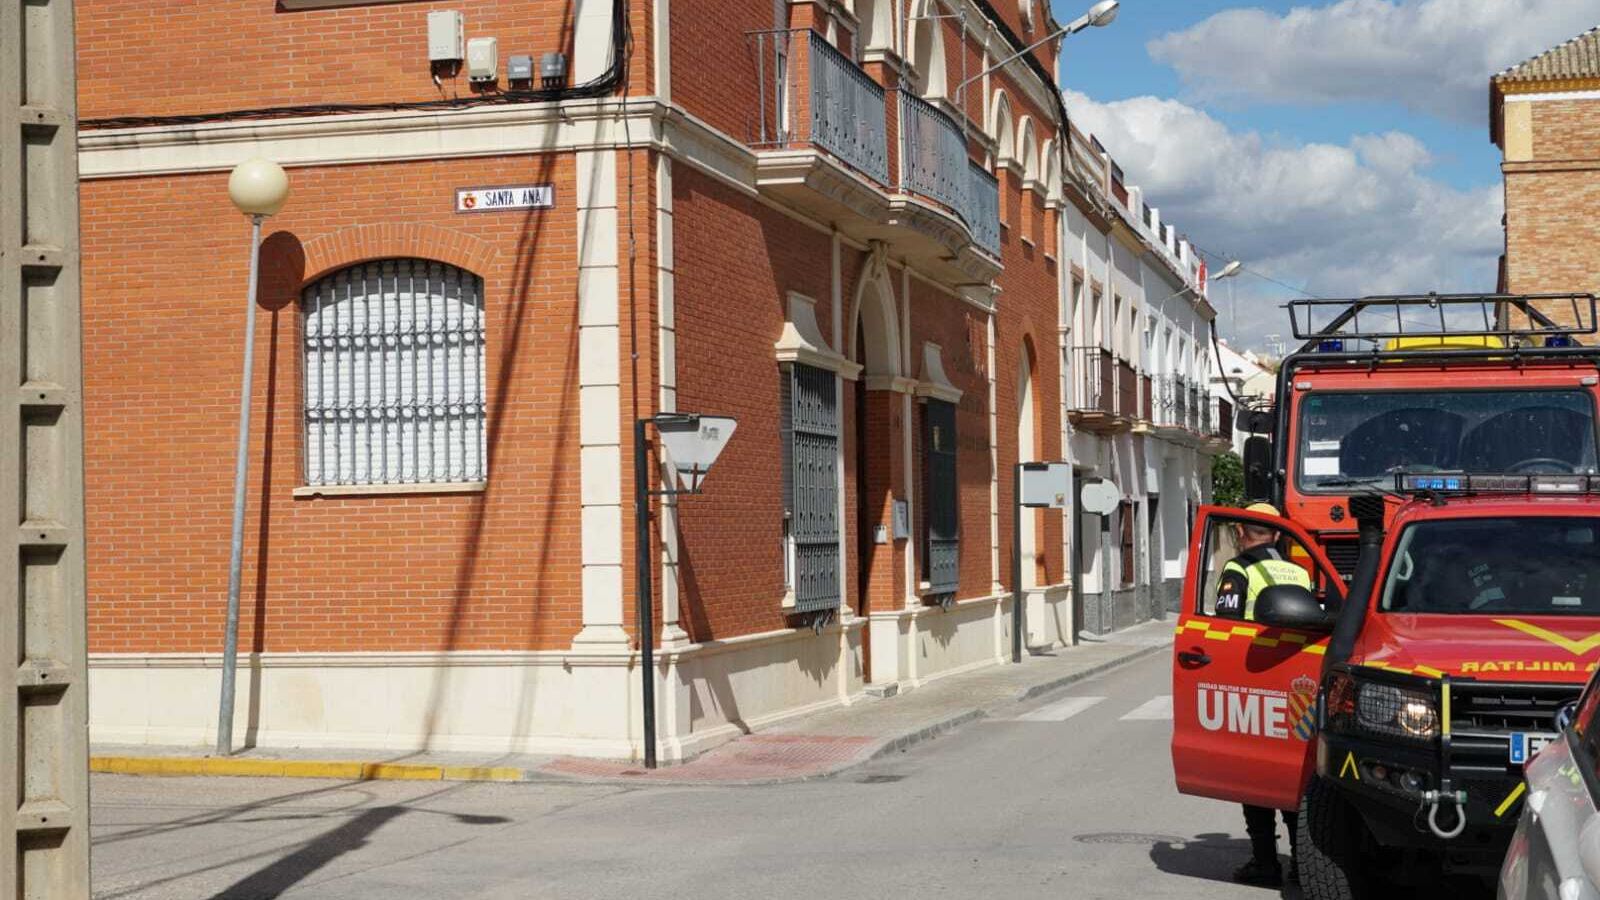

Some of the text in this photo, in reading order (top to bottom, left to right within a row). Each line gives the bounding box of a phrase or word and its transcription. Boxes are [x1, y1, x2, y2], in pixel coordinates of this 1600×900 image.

[485, 189, 542, 206] SANTA ANA
[1216, 594, 1239, 609] PM
[1197, 682, 1218, 690] UNIDAD
[1218, 684, 1239, 692] MILITAR
[1197, 690, 1288, 739] UME
